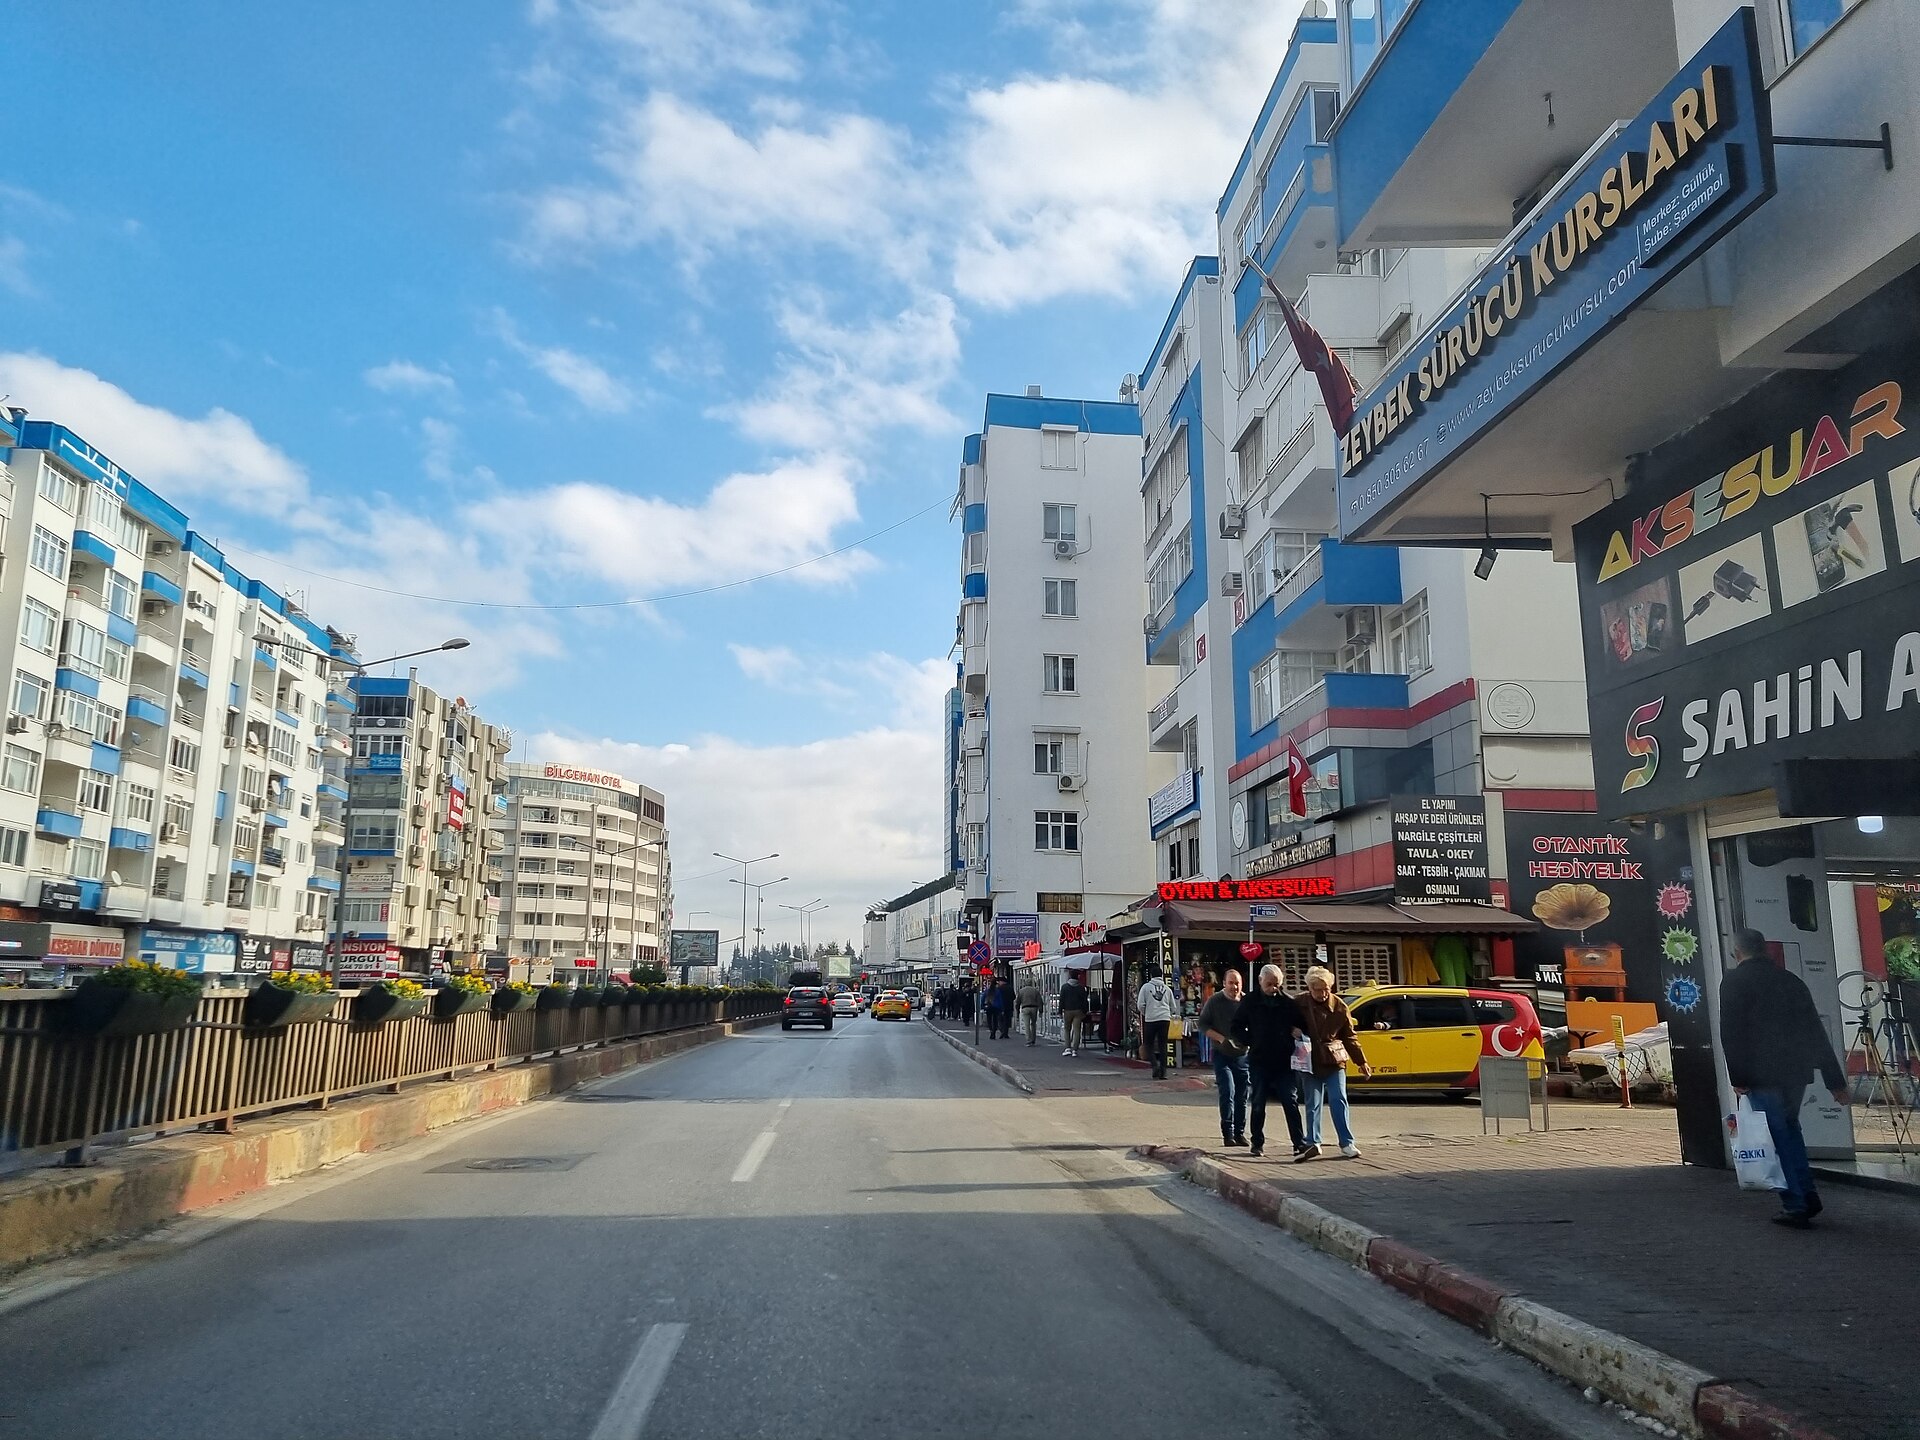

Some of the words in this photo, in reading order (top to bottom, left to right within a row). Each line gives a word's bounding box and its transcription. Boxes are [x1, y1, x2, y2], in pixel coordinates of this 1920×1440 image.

[1642, 192, 1680, 235] Merkez:
[1681, 162, 1716, 200] Güllük
[1644, 223, 1672, 254] Şube:
[1674, 173, 1724, 227] Şarampol
[1340, 372, 1413, 477] ZEYBEK
[1418, 255, 1523, 402] SÜRÜCÜ
[1530, 65, 1718, 296] KURSLARI
[1366, 479, 1382, 504] 850
[1384, 463, 1400, 490] 305
[1403, 451, 1415, 473] 62
[1417, 437, 1430, 461] 67
[1597, 381, 1906, 584] AKSESUAR
[545, 765, 600, 784] BİLGEHAN
[601, 775, 621, 789] OTEL
[1421, 799, 1431, 810] EL
[1431, 799, 1456, 810] YAPIMI
[1394, 813, 1418, 825] AHŞAP
[1420, 813, 1429, 823] VE
[1431, 812, 1448, 824] DERİ
[1448, 812, 1484, 825] ÜRÜNLERİ
[1397, 830, 1436, 842] NARGİLE
[1437, 831, 1482, 844] ÇEŞİTLERİ
[1533, 834, 1630, 855] OTANTİK
[1407, 848, 1439, 858] TAVLA
[1446, 849, 1474, 859] OKEY
[1397, 865, 1416, 876] SAAT
[1421, 864, 1449, 877] TESBİH
[1454, 866, 1486, 880] ÇAKMAK
[1529, 858, 1644, 880] HEDİYELİK
[1160, 883, 1213, 900] OYUN
[1218, 882, 1233, 899] &
[1237, 878, 1333, 898] AKSESUAR
[1425, 884, 1460, 895] OSMANLI
[241, 960, 256, 970] CEP
[256, 960, 273, 970] CITY
